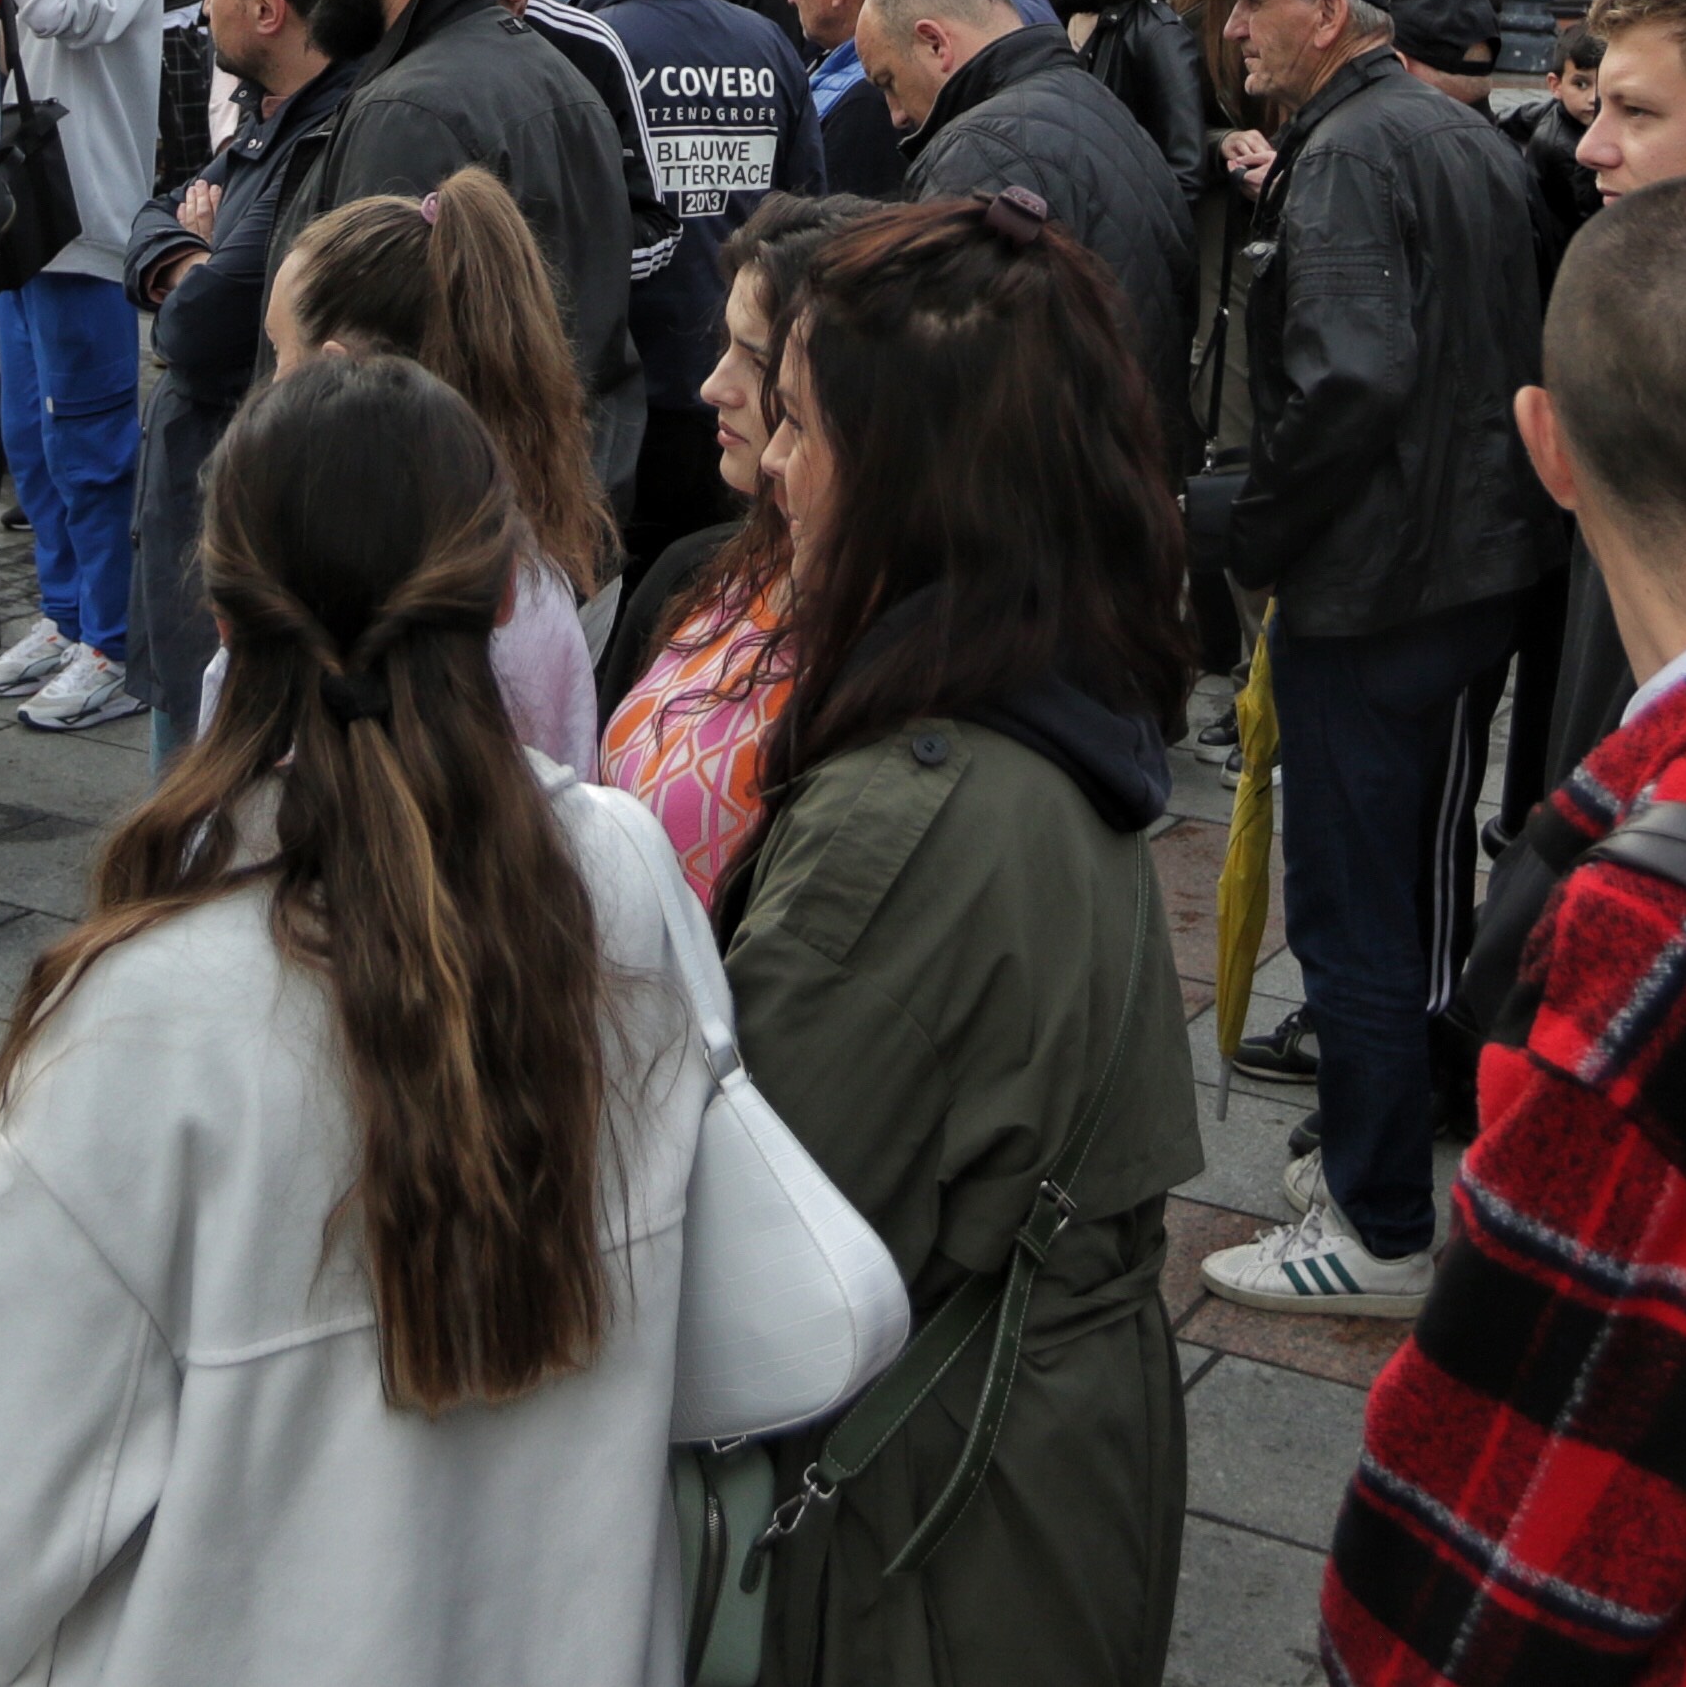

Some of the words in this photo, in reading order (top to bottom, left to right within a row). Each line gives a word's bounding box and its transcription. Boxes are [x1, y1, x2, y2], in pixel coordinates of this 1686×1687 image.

[659, 65, 775, 98] COVEBO
[656, 140, 751, 163] BLAUWE
[658, 163, 771, 187] TTERRACE
